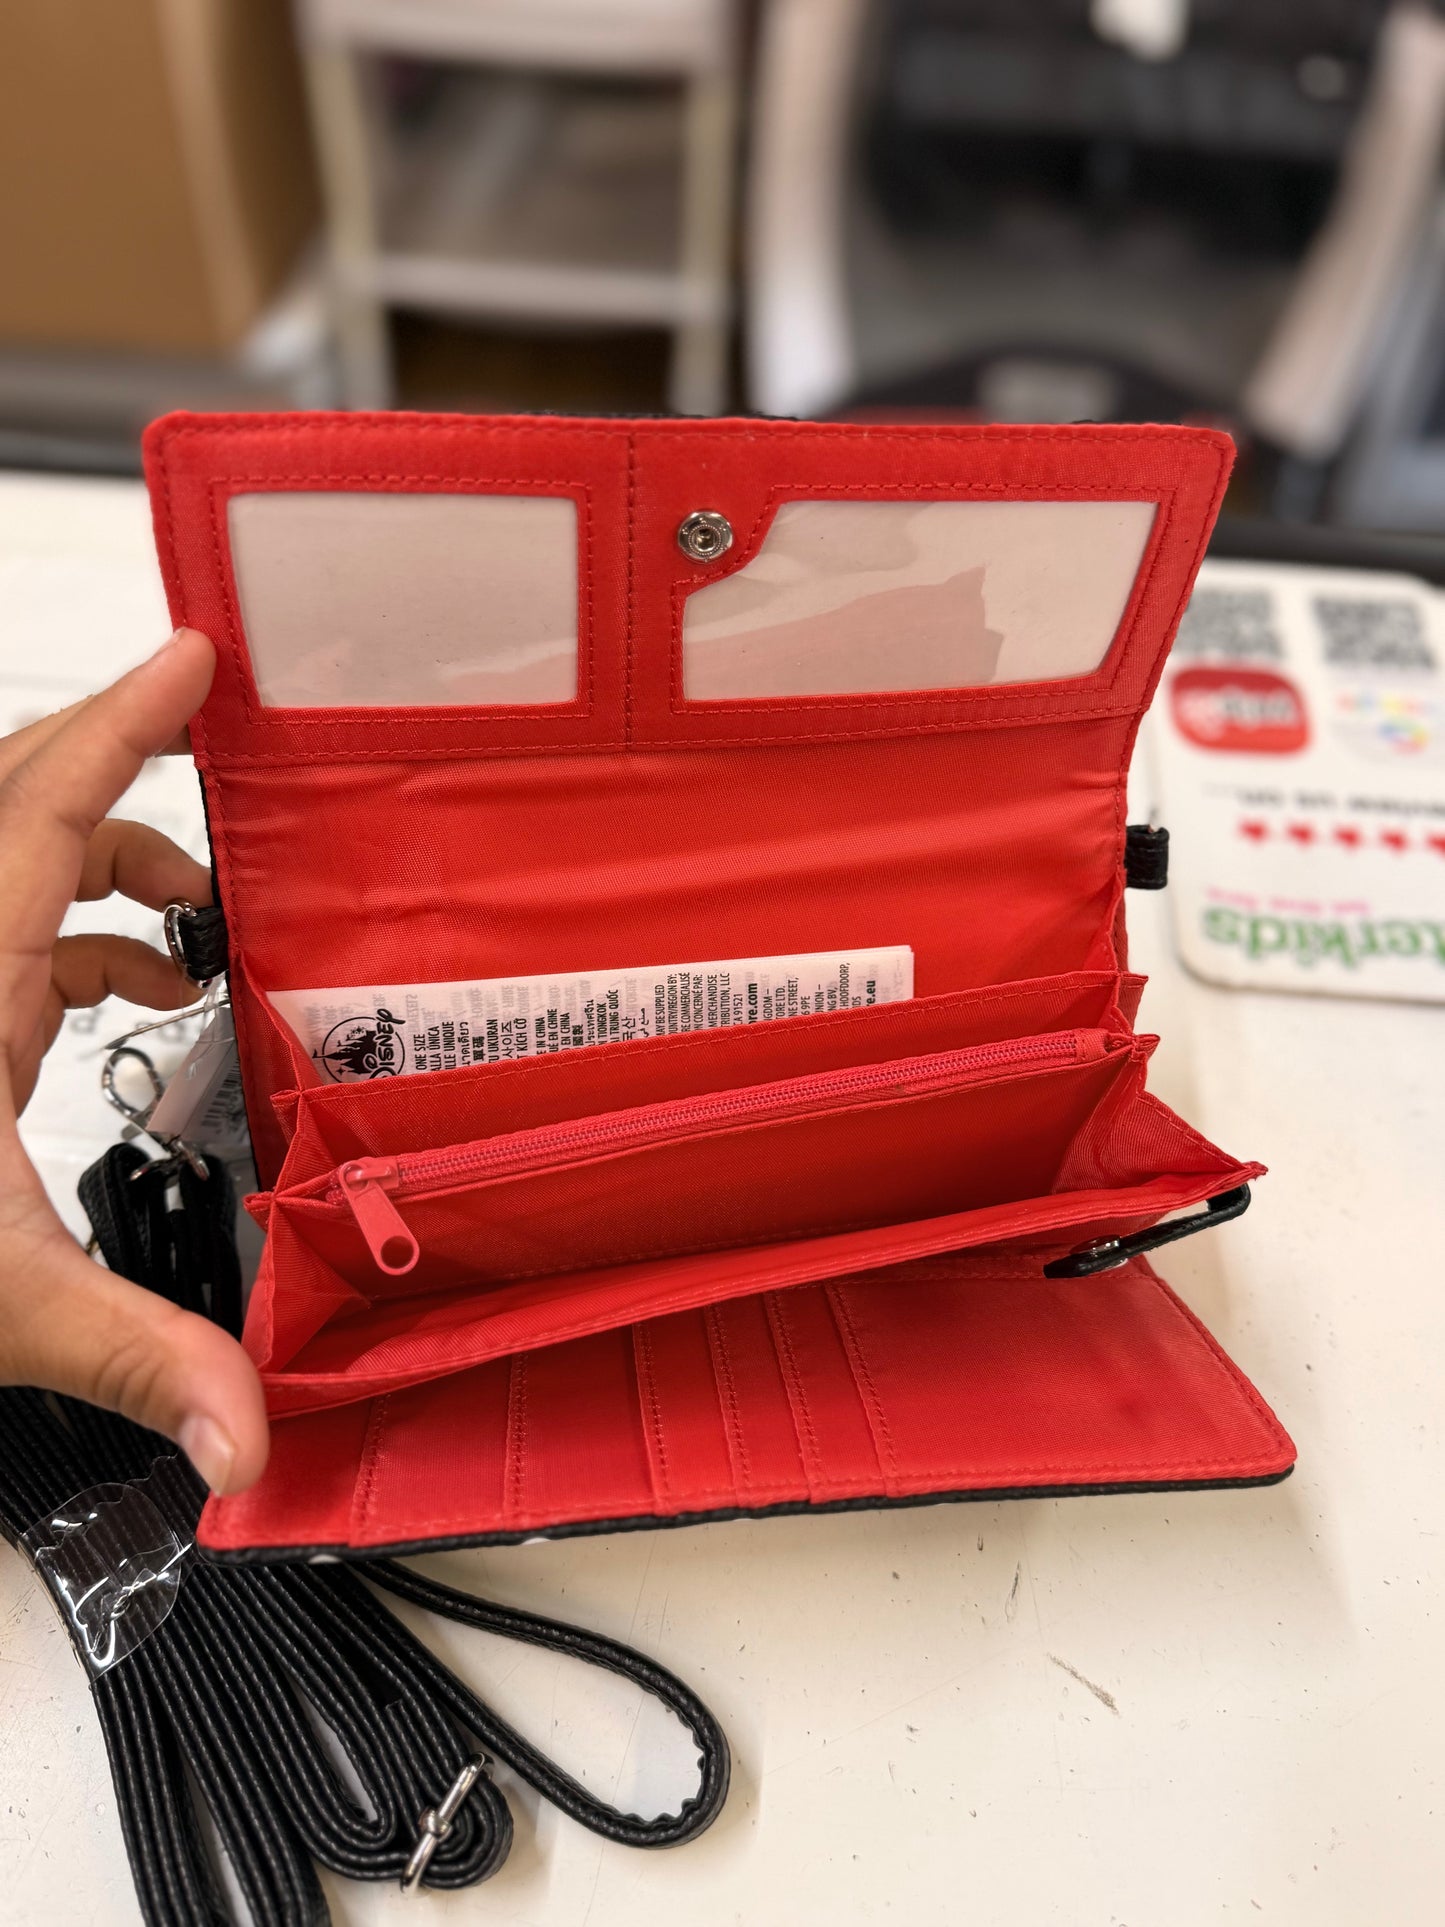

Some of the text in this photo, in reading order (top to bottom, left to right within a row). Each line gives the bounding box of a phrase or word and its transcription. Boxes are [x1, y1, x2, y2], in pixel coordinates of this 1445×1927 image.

[668, 974, 677, 984] BY:
[693, 974, 703, 989] PAR:
[720, 973, 730, 986] LLC
[839, 962, 851, 1006] HOOFDDORP,
[606, 989, 618, 1009] QUỐC
[655, 985, 665, 1014] SUPPLIED
[679, 972, 690, 1023] COMMERCIALISÉ
[708, 975, 718, 1027] MERCHANDISE
[775, 985, 785, 1001] LTD.
[788, 977, 799, 1005] STREET,
[827, 987, 838, 998] BV,
[692, 990, 703, 1022] CONCERNÉ
[733, 994, 742, 1015] 91521
[801, 996, 810, 1009] 9PE
[535, 1017, 545, 1038] CHINA
[547, 1009, 558, 1029] CHINE
[560, 1013, 570, 1034] CHINA
[597, 1003, 607, 1038] TIONGKOK
[609, 1012, 619, 1034] TRUNG
[427, 1026, 440, 1050] ÚNICA
[442, 1021, 455, 1051] UNIQUE
[487, 1019, 499, 1052] UKURAN
[500, 1021, 514, 1058] 사이즈
[514, 1032, 528, 1051] KÍCH
[548, 1032, 558, 1040] EN
[561, 1037, 571, 1045] EN
[414, 1034, 427, 1070] ONE SIZE
